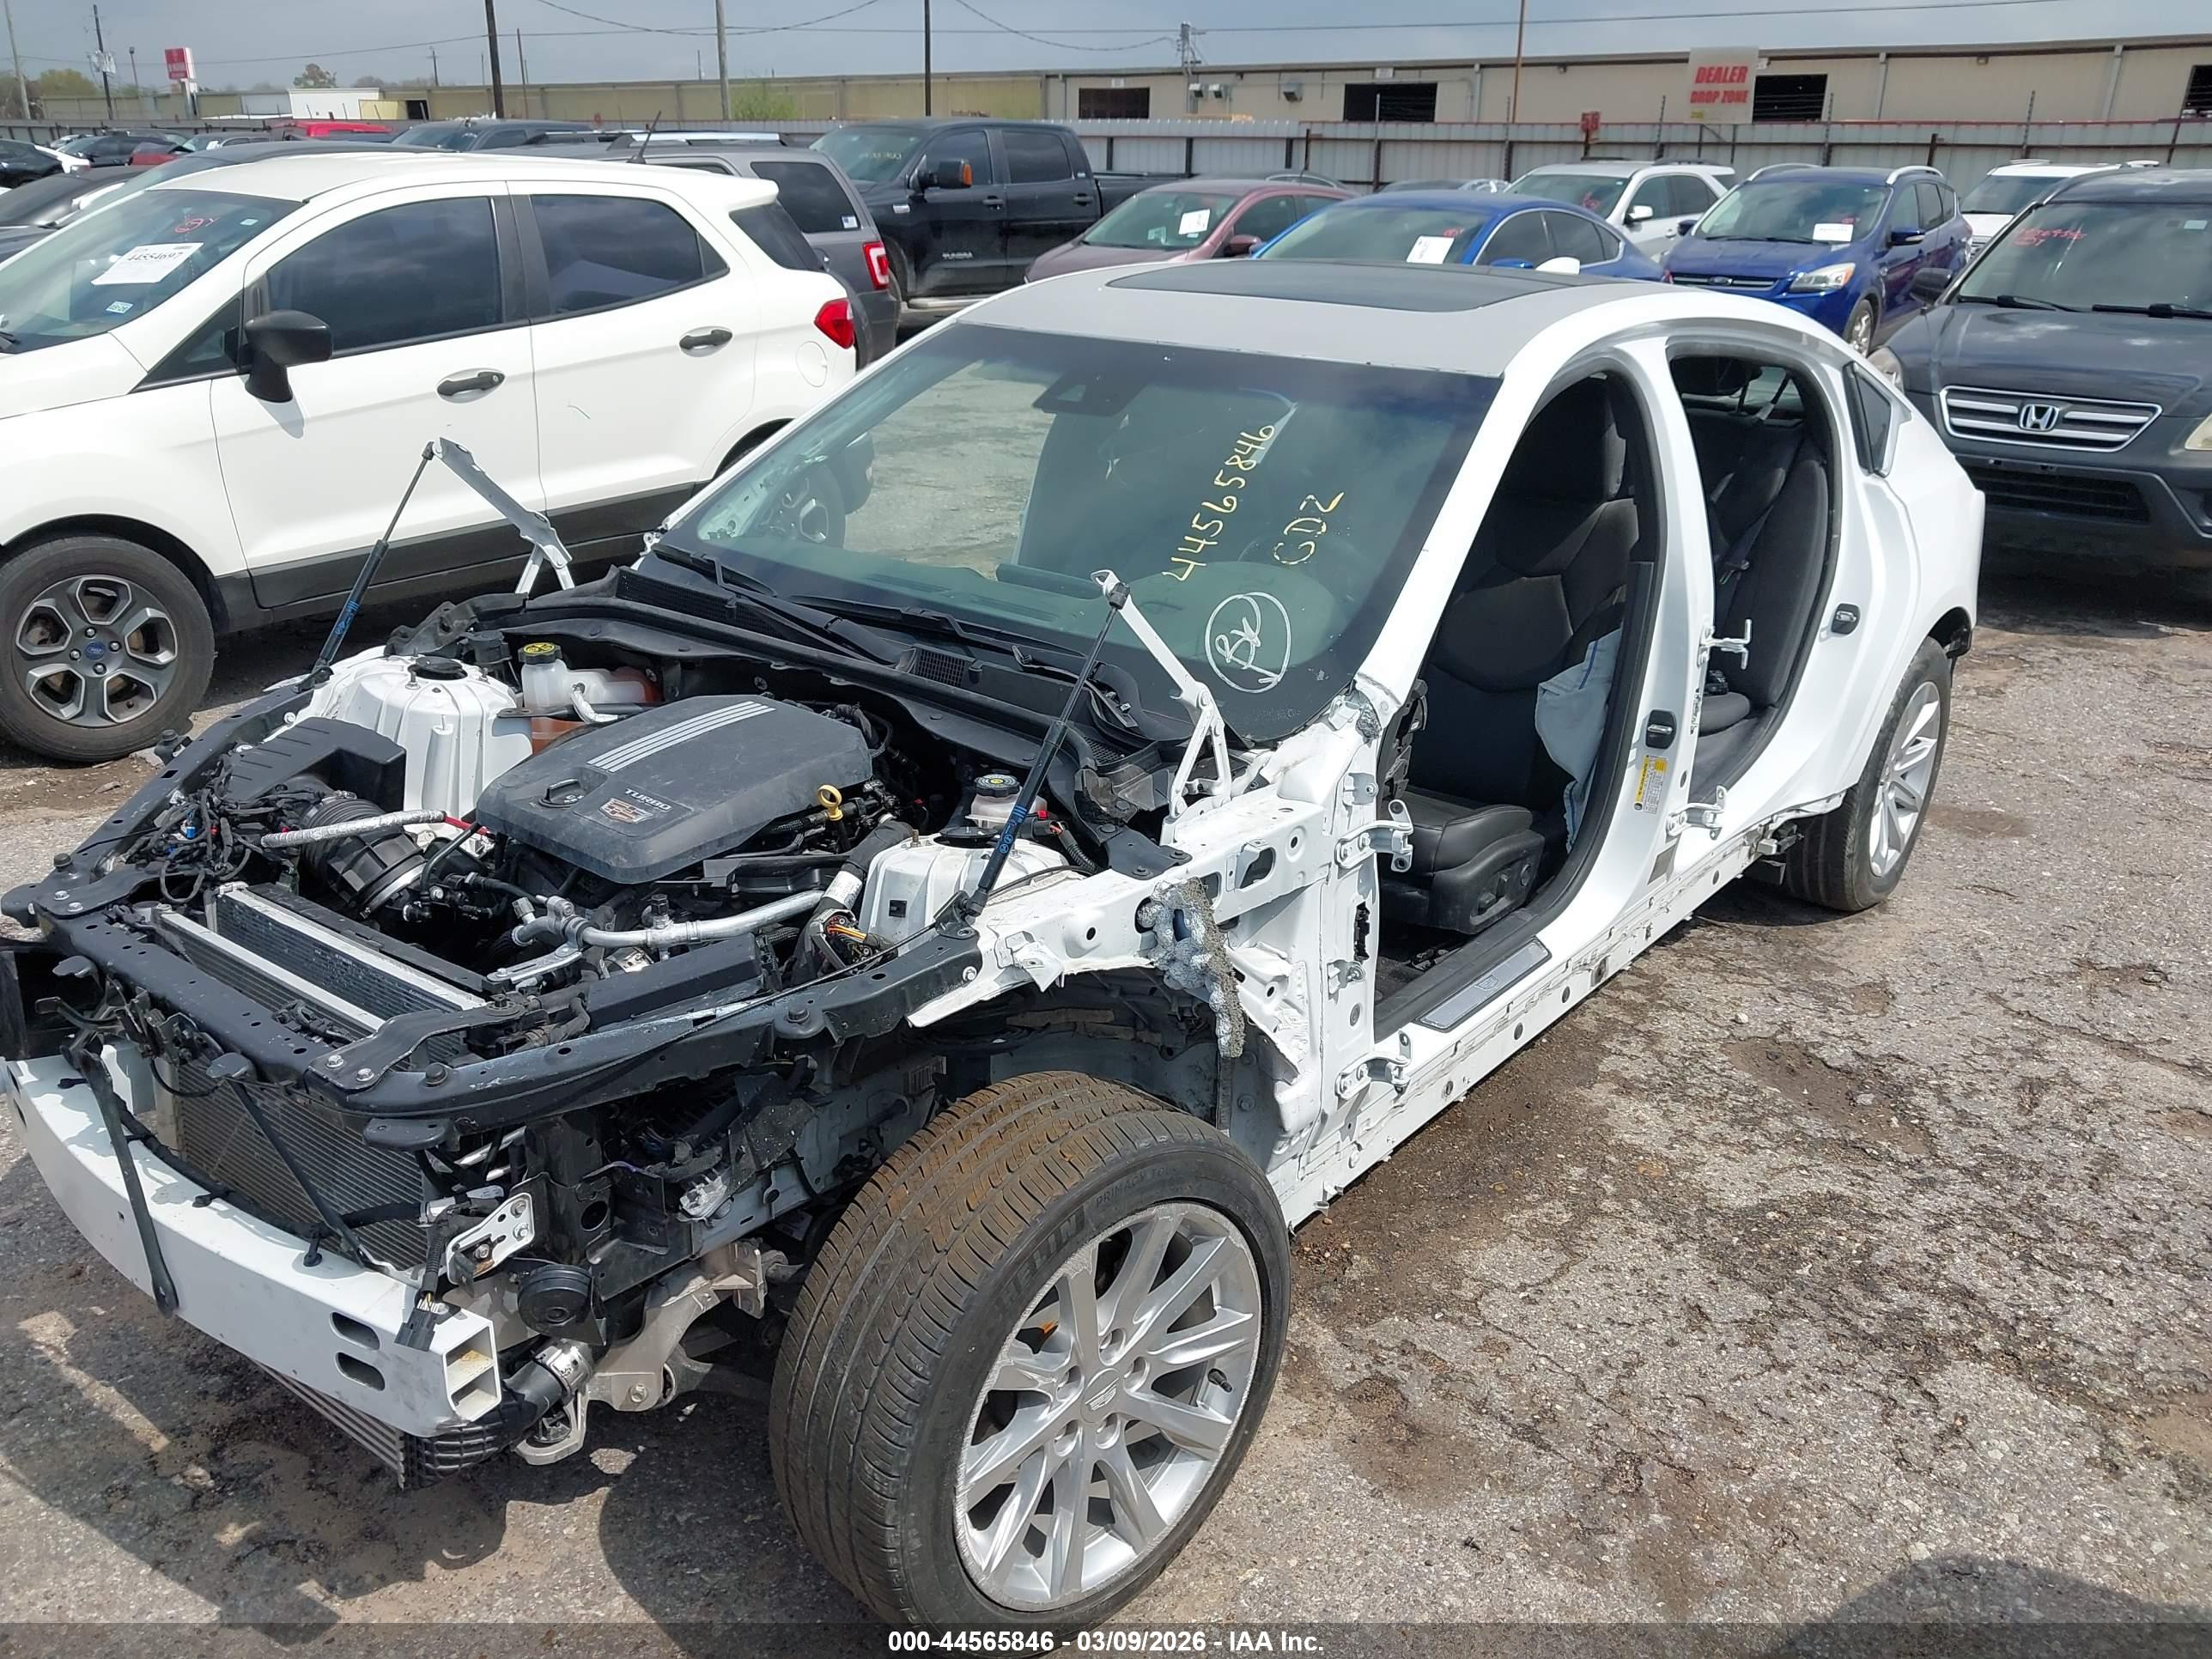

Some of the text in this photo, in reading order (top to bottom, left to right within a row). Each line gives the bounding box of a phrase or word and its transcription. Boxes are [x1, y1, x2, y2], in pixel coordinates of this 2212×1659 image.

[1694, 65, 1748, 83] DEALER
[1689, 89, 1748, 104] DROP ZONE
[1162, 425, 1275, 581] 44565846
[624, 787, 672, 811] TURBO
